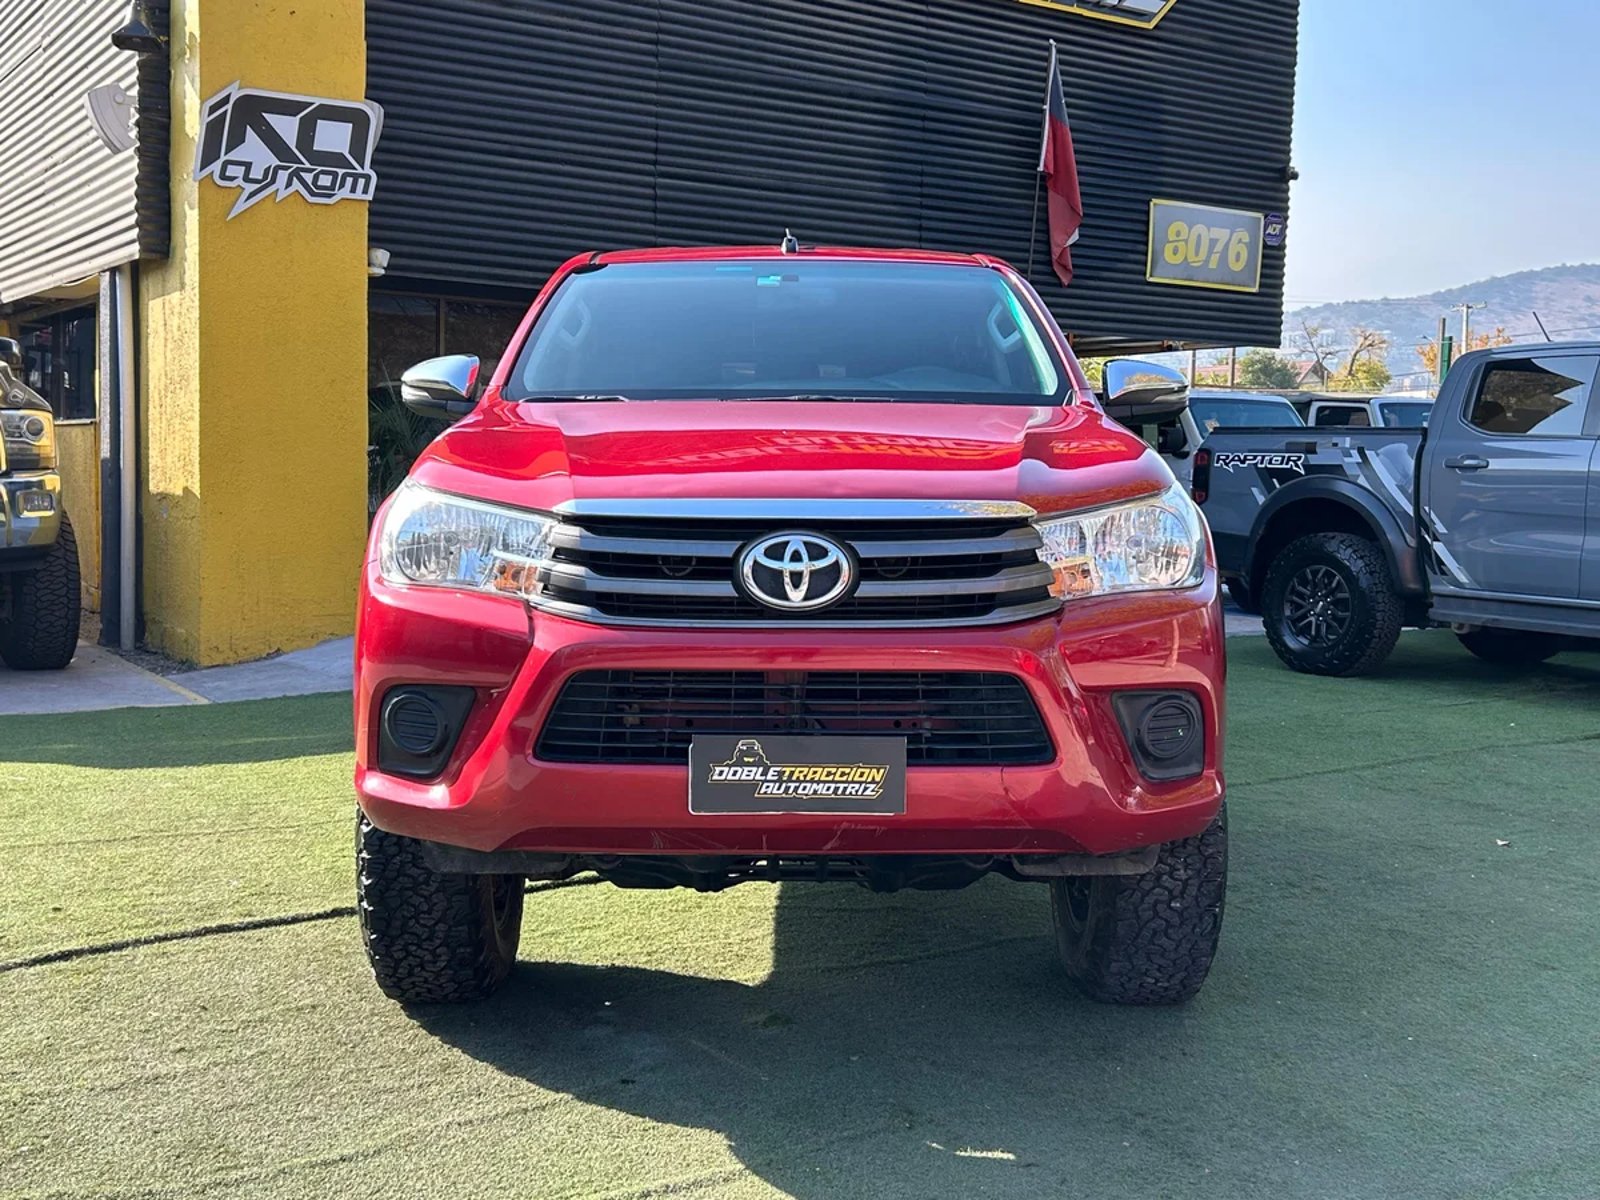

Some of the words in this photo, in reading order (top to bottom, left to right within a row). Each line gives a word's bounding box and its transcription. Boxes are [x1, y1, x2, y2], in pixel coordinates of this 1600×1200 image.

[1164, 221, 1250, 272] 8076
[1214, 453, 1305, 476] RAPTOR
[760, 782, 877, 796] AUTOMOTRIZ
